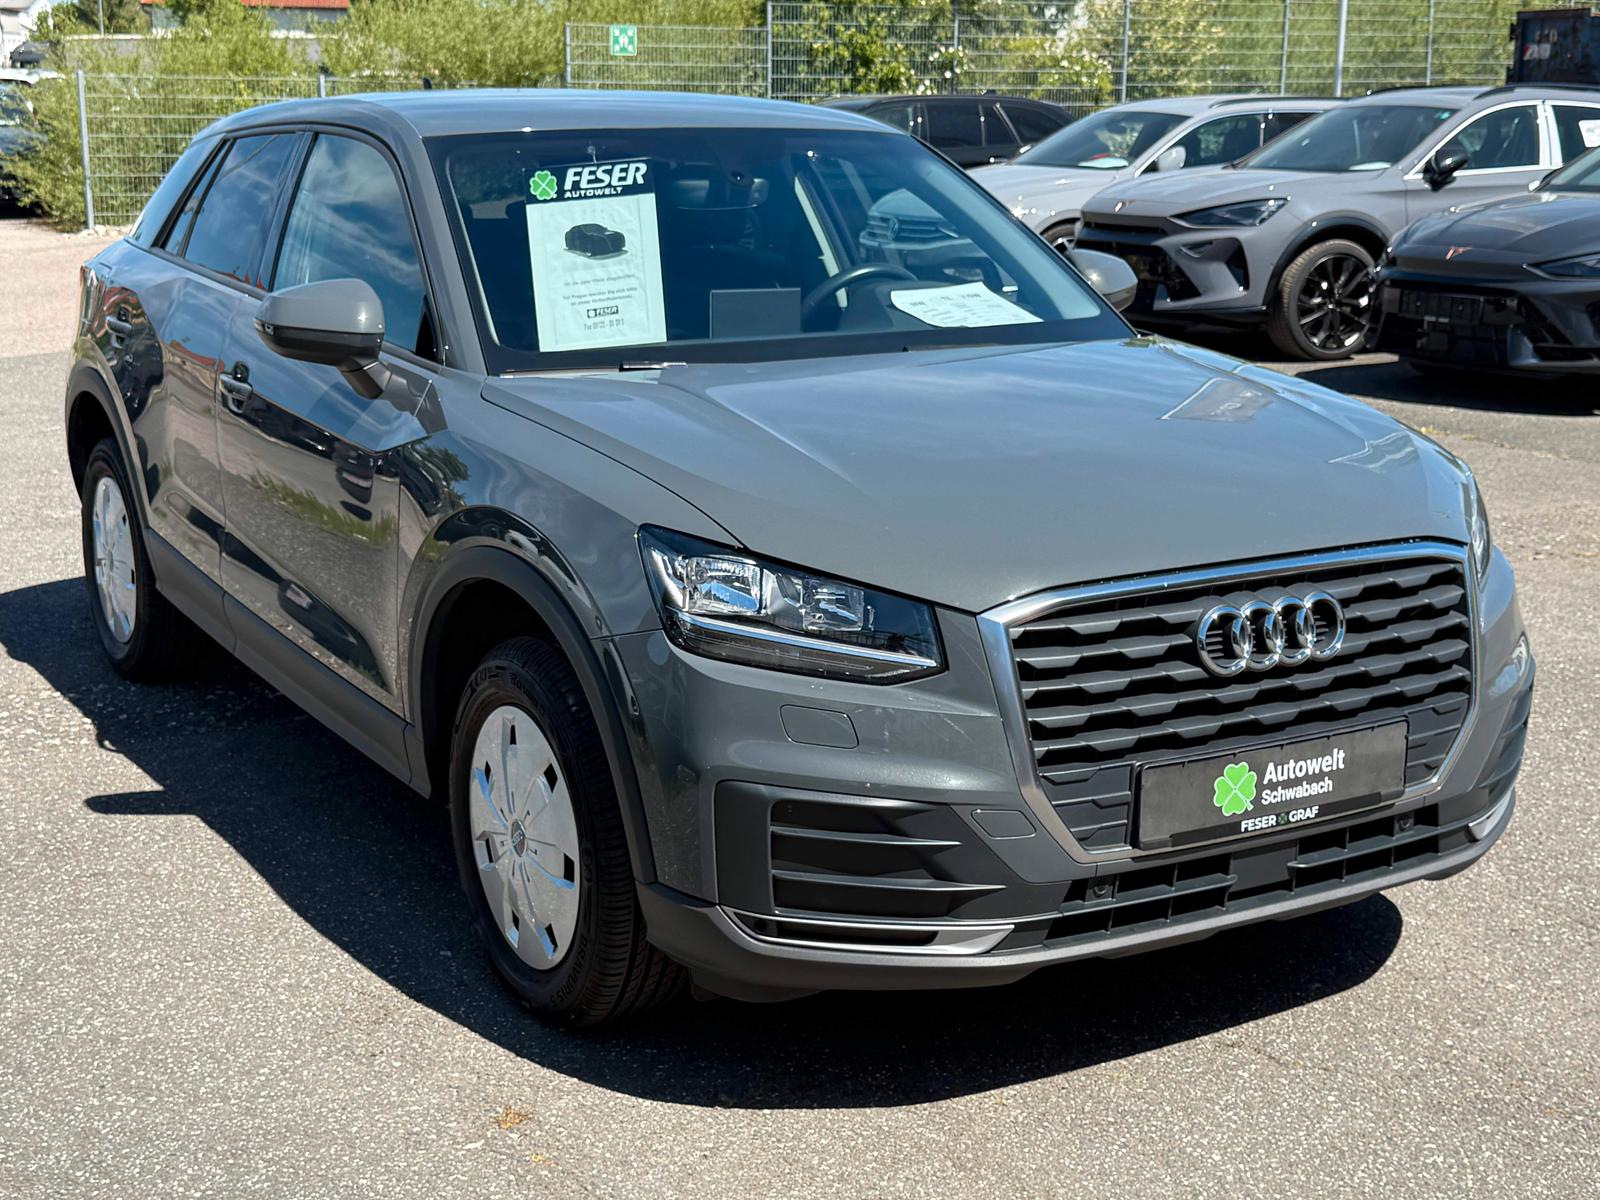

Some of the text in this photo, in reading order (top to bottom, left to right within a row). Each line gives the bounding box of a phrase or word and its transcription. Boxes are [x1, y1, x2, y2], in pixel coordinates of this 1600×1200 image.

[564, 163, 647, 189] FESER
[564, 187, 623, 198] AUTOWELT
[1263, 749, 1345, 784] Autowelt
[1261, 776, 1333, 806] Schwabach
[1240, 806, 1320, 833] FESER GRAF
